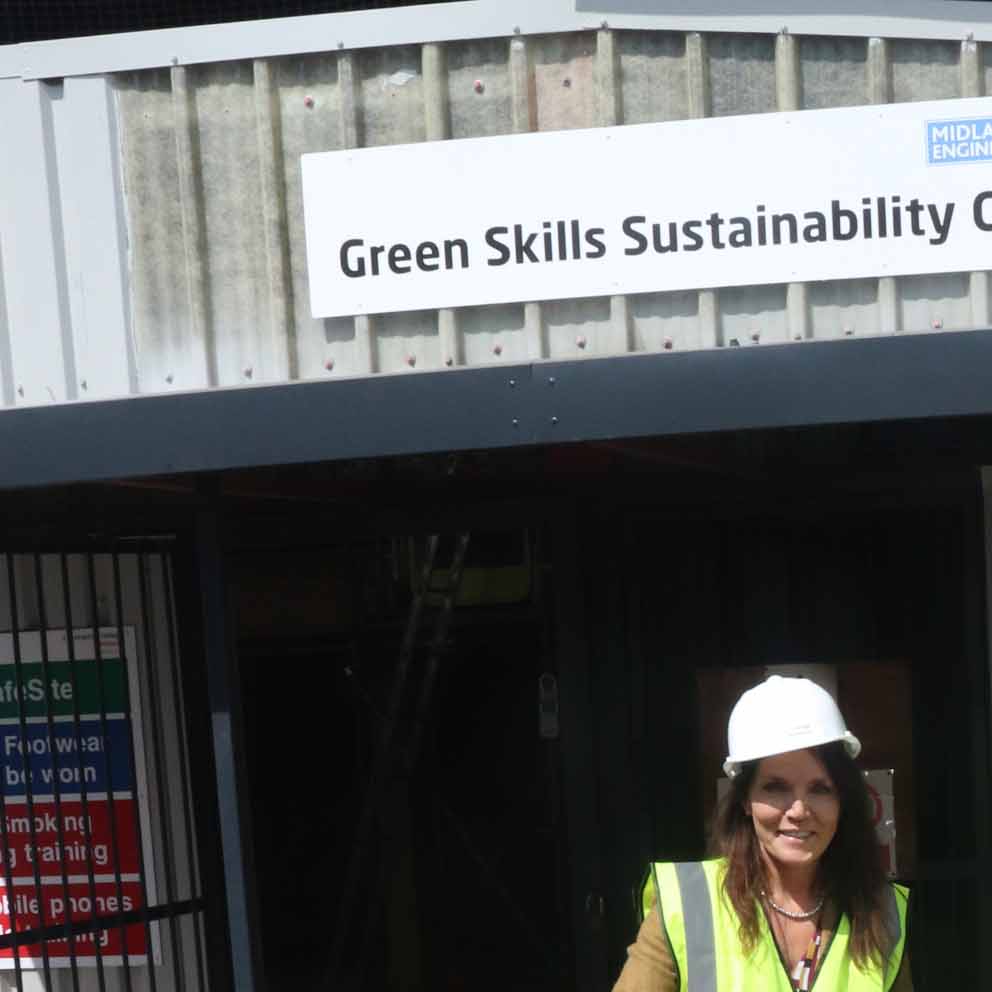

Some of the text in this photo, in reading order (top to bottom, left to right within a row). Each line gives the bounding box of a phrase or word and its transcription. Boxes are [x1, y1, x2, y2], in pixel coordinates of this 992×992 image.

[340, 238, 470, 279] Green
[485, 219, 607, 266] Skills
[622, 195, 956, 256] Sustainability
[24, 840, 109, 866] taining
